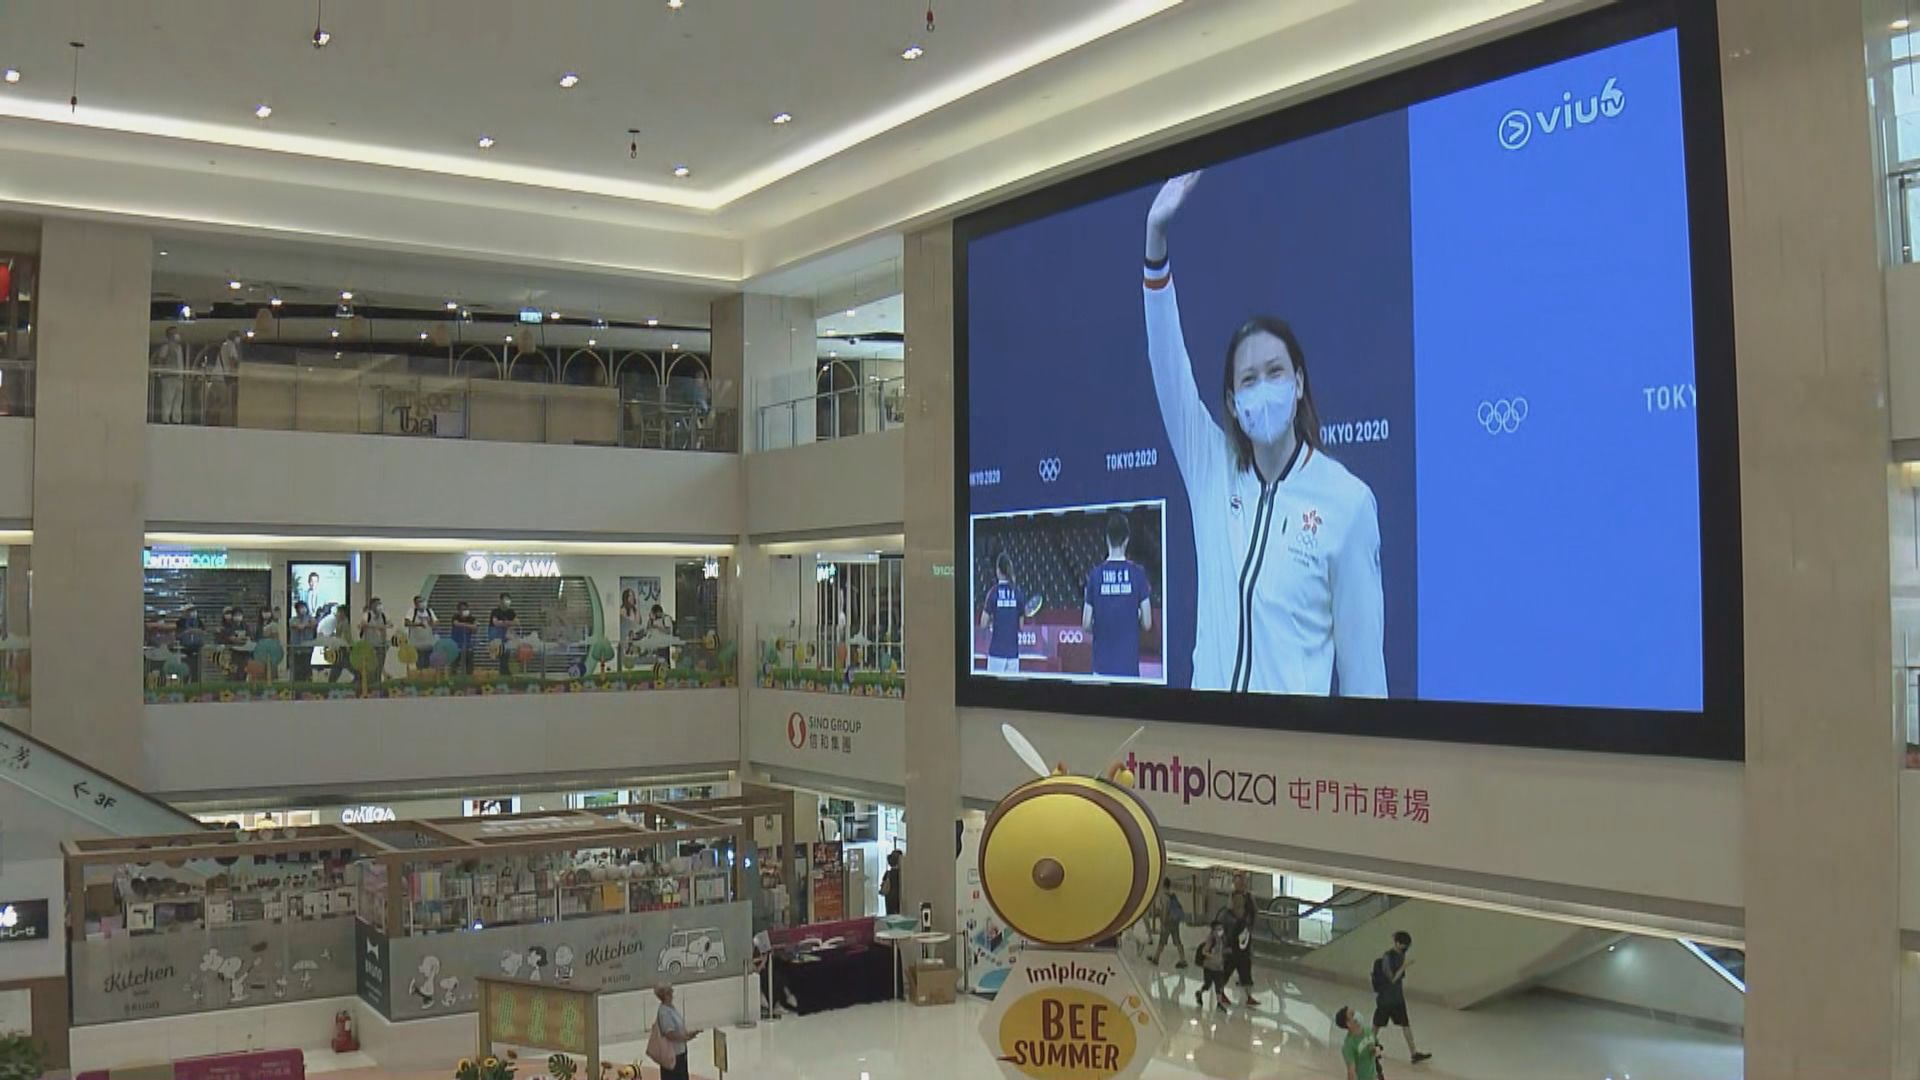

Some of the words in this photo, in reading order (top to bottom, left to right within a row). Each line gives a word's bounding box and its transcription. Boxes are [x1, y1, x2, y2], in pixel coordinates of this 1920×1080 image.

[1355, 419, 1389, 442] 2020
[1106, 451, 1134, 471] TOKYO
[1135, 448, 1157, 467] 2020
[492, 559, 561, 577] OGAWA
[1018, 632, 1036, 645] 2020
[809, 715, 829, 729] SINO
[831, 718, 862, 733] GROUP
[1126, 752, 1277, 805] tmtplaza
[94, 793, 117, 809] 3F
[1288, 777, 1430, 824] 屯門市廣場
[585, 940, 644, 967] Kitchen
[104, 965, 176, 993] Kitchen
[1026, 961, 1109, 986] tmtplaza
[1041, 998, 1108, 1042] BEE
[1013, 1039, 1120, 1071] SUMMER
